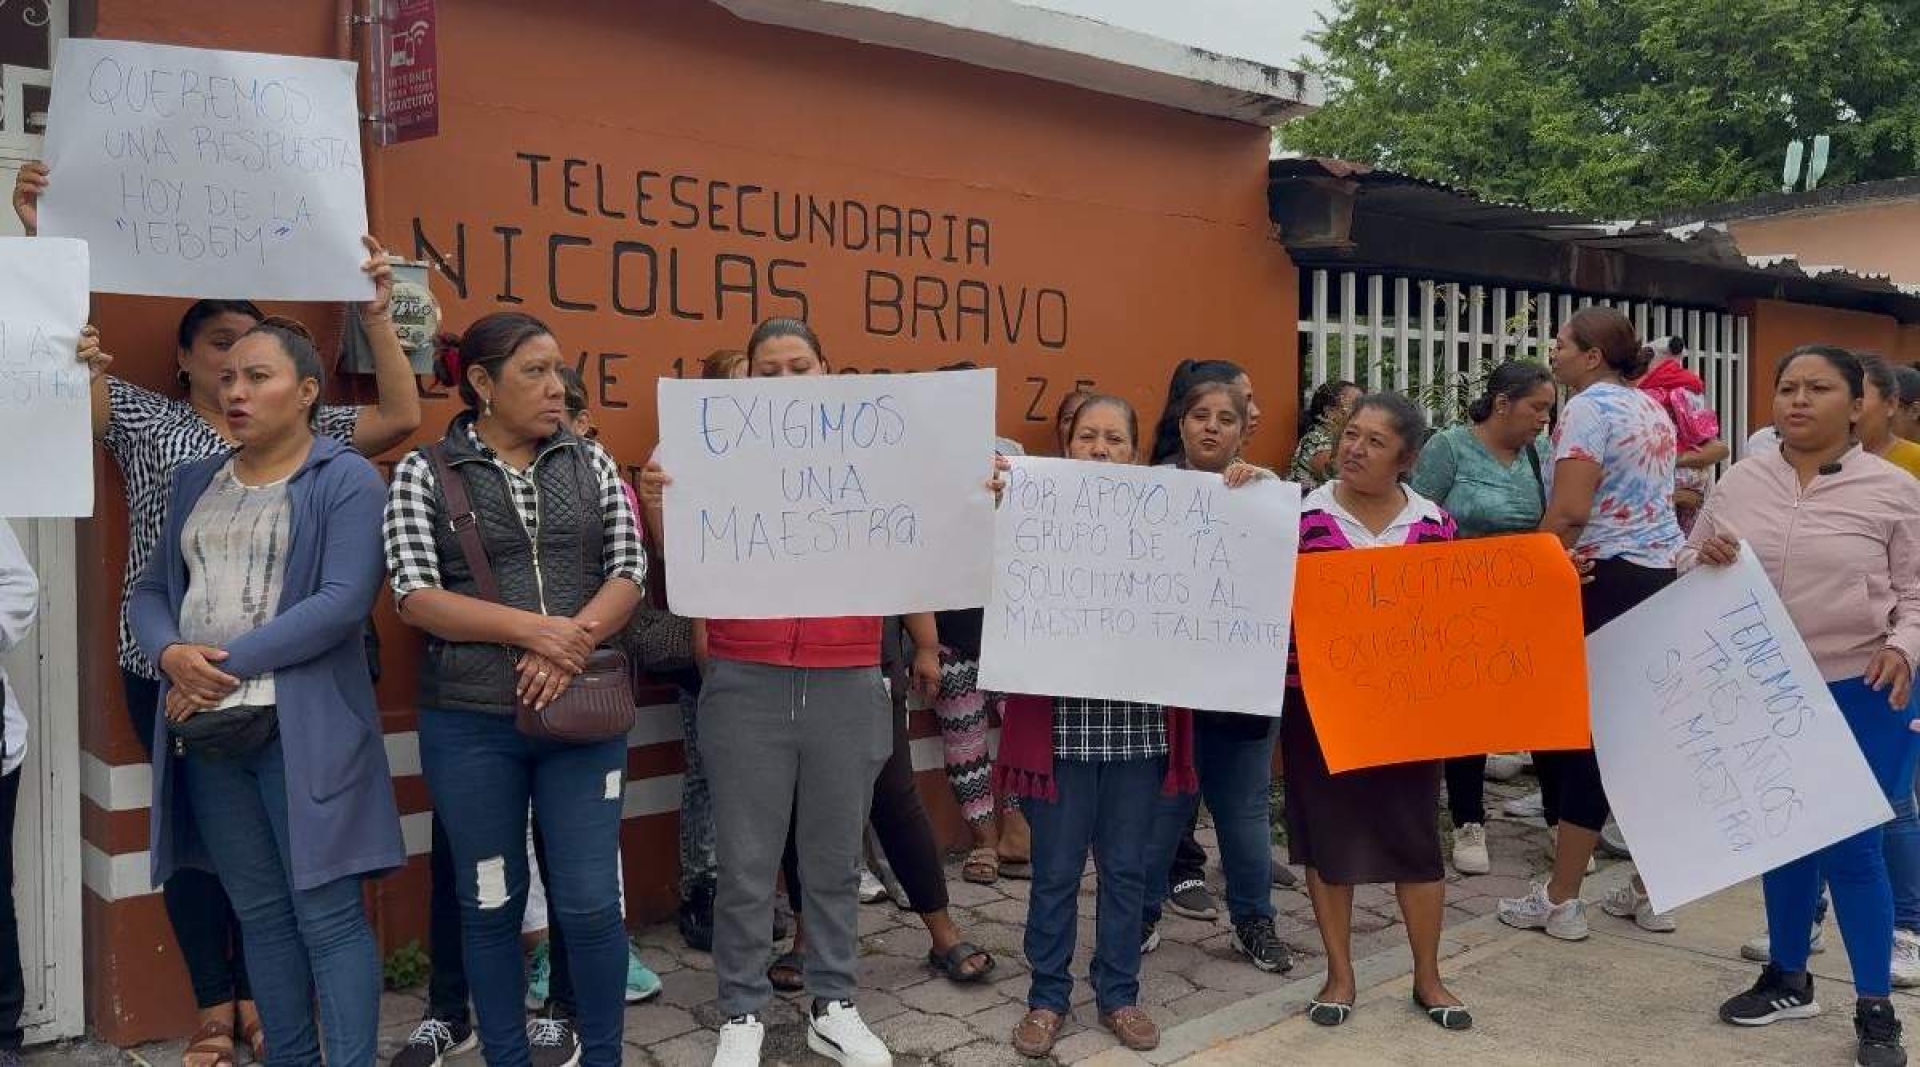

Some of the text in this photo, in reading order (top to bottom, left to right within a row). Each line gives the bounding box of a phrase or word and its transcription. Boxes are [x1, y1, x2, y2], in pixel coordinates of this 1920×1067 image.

[90, 57, 312, 124] QUEREMOS
[105, 127, 358, 172] UNA RESPUESTA
[121, 172, 310, 225] HOY DE LA
[516, 152, 990, 266] TELESECUNDARIA
[412, 217, 1068, 349] NICOLAS BRAVO
[699, 394, 906, 455] EXIGIMOS
[781, 464, 868, 505] UNA
[1008, 467, 1058, 517] POR
[1184, 486, 1230, 526] AL
[1014, 517, 1109, 556] GRUPO
[1126, 527, 1166, 561] DE
[1003, 557, 1252, 611] SOLICITAMOS AL
[1318, 545, 1536, 613] SOLICITAMOS
[1003, 604, 1285, 648] MAESTRO FALTANTE
[1646, 649, 1694, 716] SIN
[1689, 629, 1742, 726] TRES
[1719, 588, 1815, 739] TENEMOS
